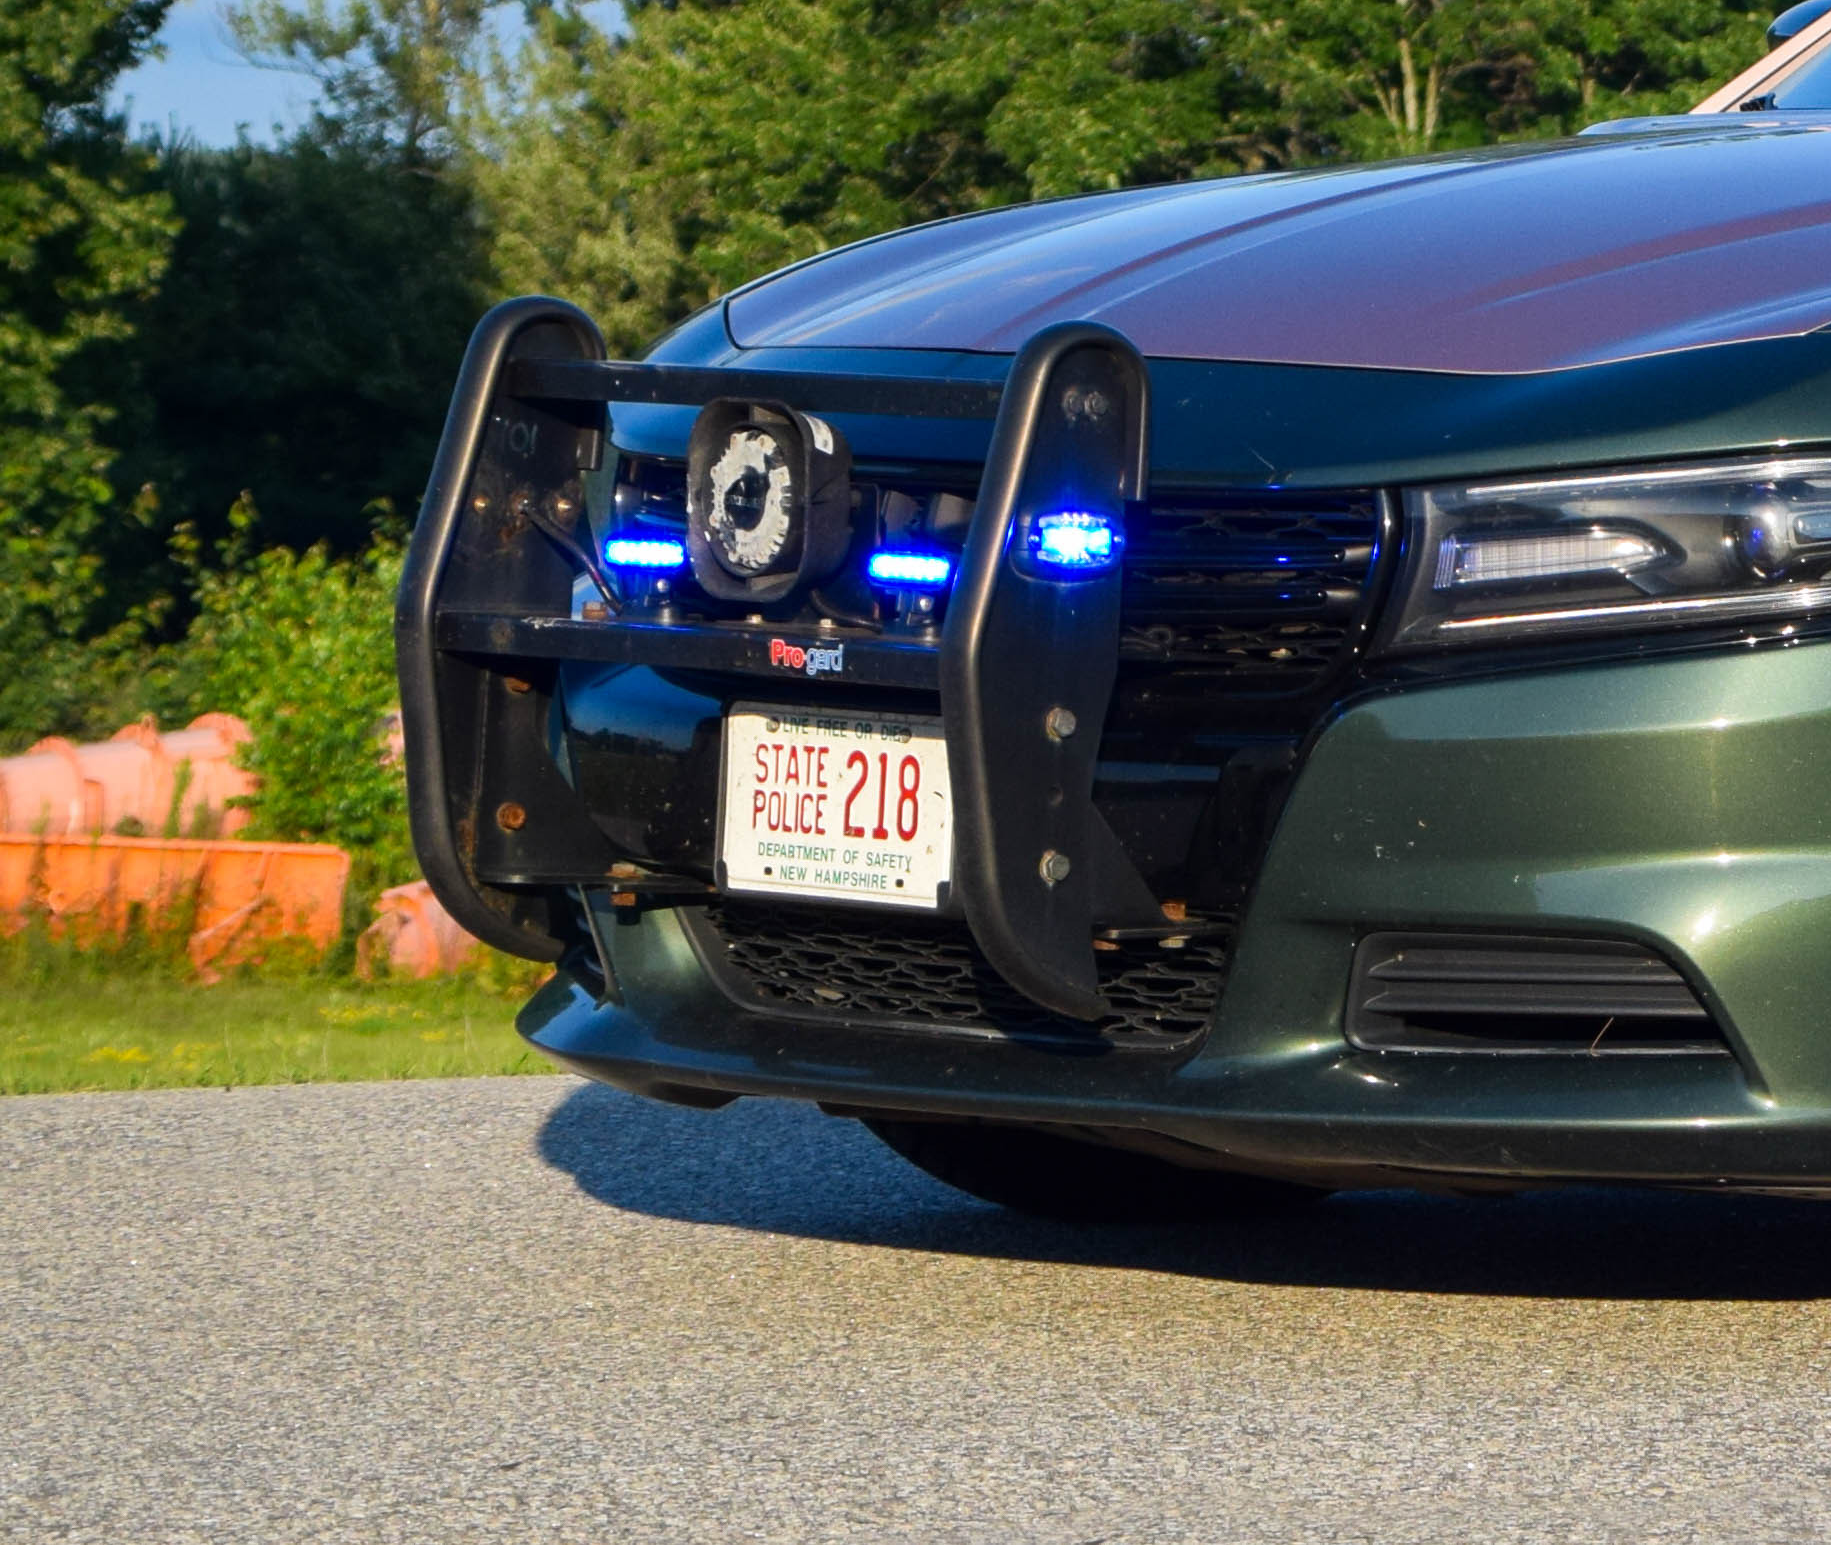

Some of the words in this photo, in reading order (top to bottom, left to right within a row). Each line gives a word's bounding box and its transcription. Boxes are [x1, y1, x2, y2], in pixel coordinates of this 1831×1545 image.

[770, 638, 844, 676] Pro-gard
[783, 716, 809, 735] LIVE
[816, 717, 848, 739] FREE
[855, 722, 873, 740] OR
[755, 743, 829, 788] STATE
[752, 790, 828, 835] POLICE
[843, 750, 921, 842] 218
[758, 841, 836, 863] DEPARTMENT
[842, 850, 859, 865] OF
[865, 851, 913, 872] SAFETY
[780, 865, 807, 882] NEW
[814, 869, 888, 889] HAMPSHIRE
